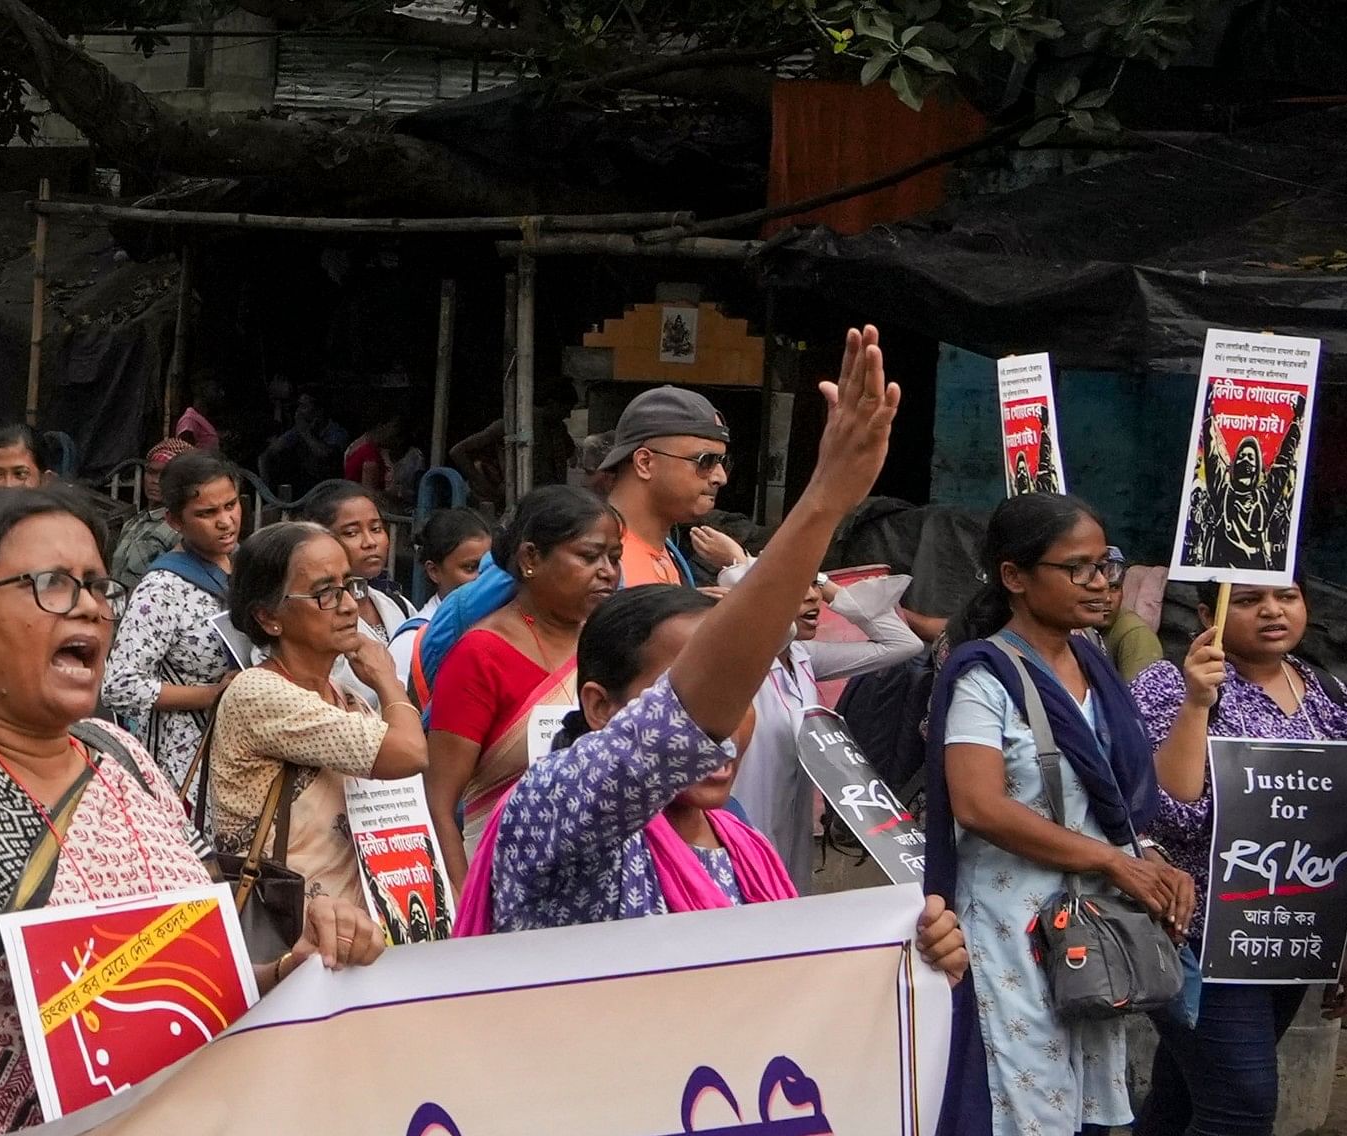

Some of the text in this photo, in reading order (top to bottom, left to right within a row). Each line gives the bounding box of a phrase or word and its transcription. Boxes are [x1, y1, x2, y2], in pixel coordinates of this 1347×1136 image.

[1212, 379, 1300, 406] বিনীত গোয়েলের
[1215, 412, 1285, 433] পদত্যাগ চাই।
[809, 730, 851, 752] Just
[844, 747, 867, 765] fo
[1243, 767, 1332, 794] Justice
[839, 779, 902, 821] RG
[1270, 796, 1308, 819] for
[1220, 839, 1287, 895] RG
[1243, 906, 1316, 926] আর জি কর
[79, 975, 101, 998] কর
[102, 954, 131, 983] মেয়ে
[131, 929, 155, 962] দেখি
[154, 909, 188, 941] কতদূর
[1229, 929, 1324, 960] বিচার চাই
